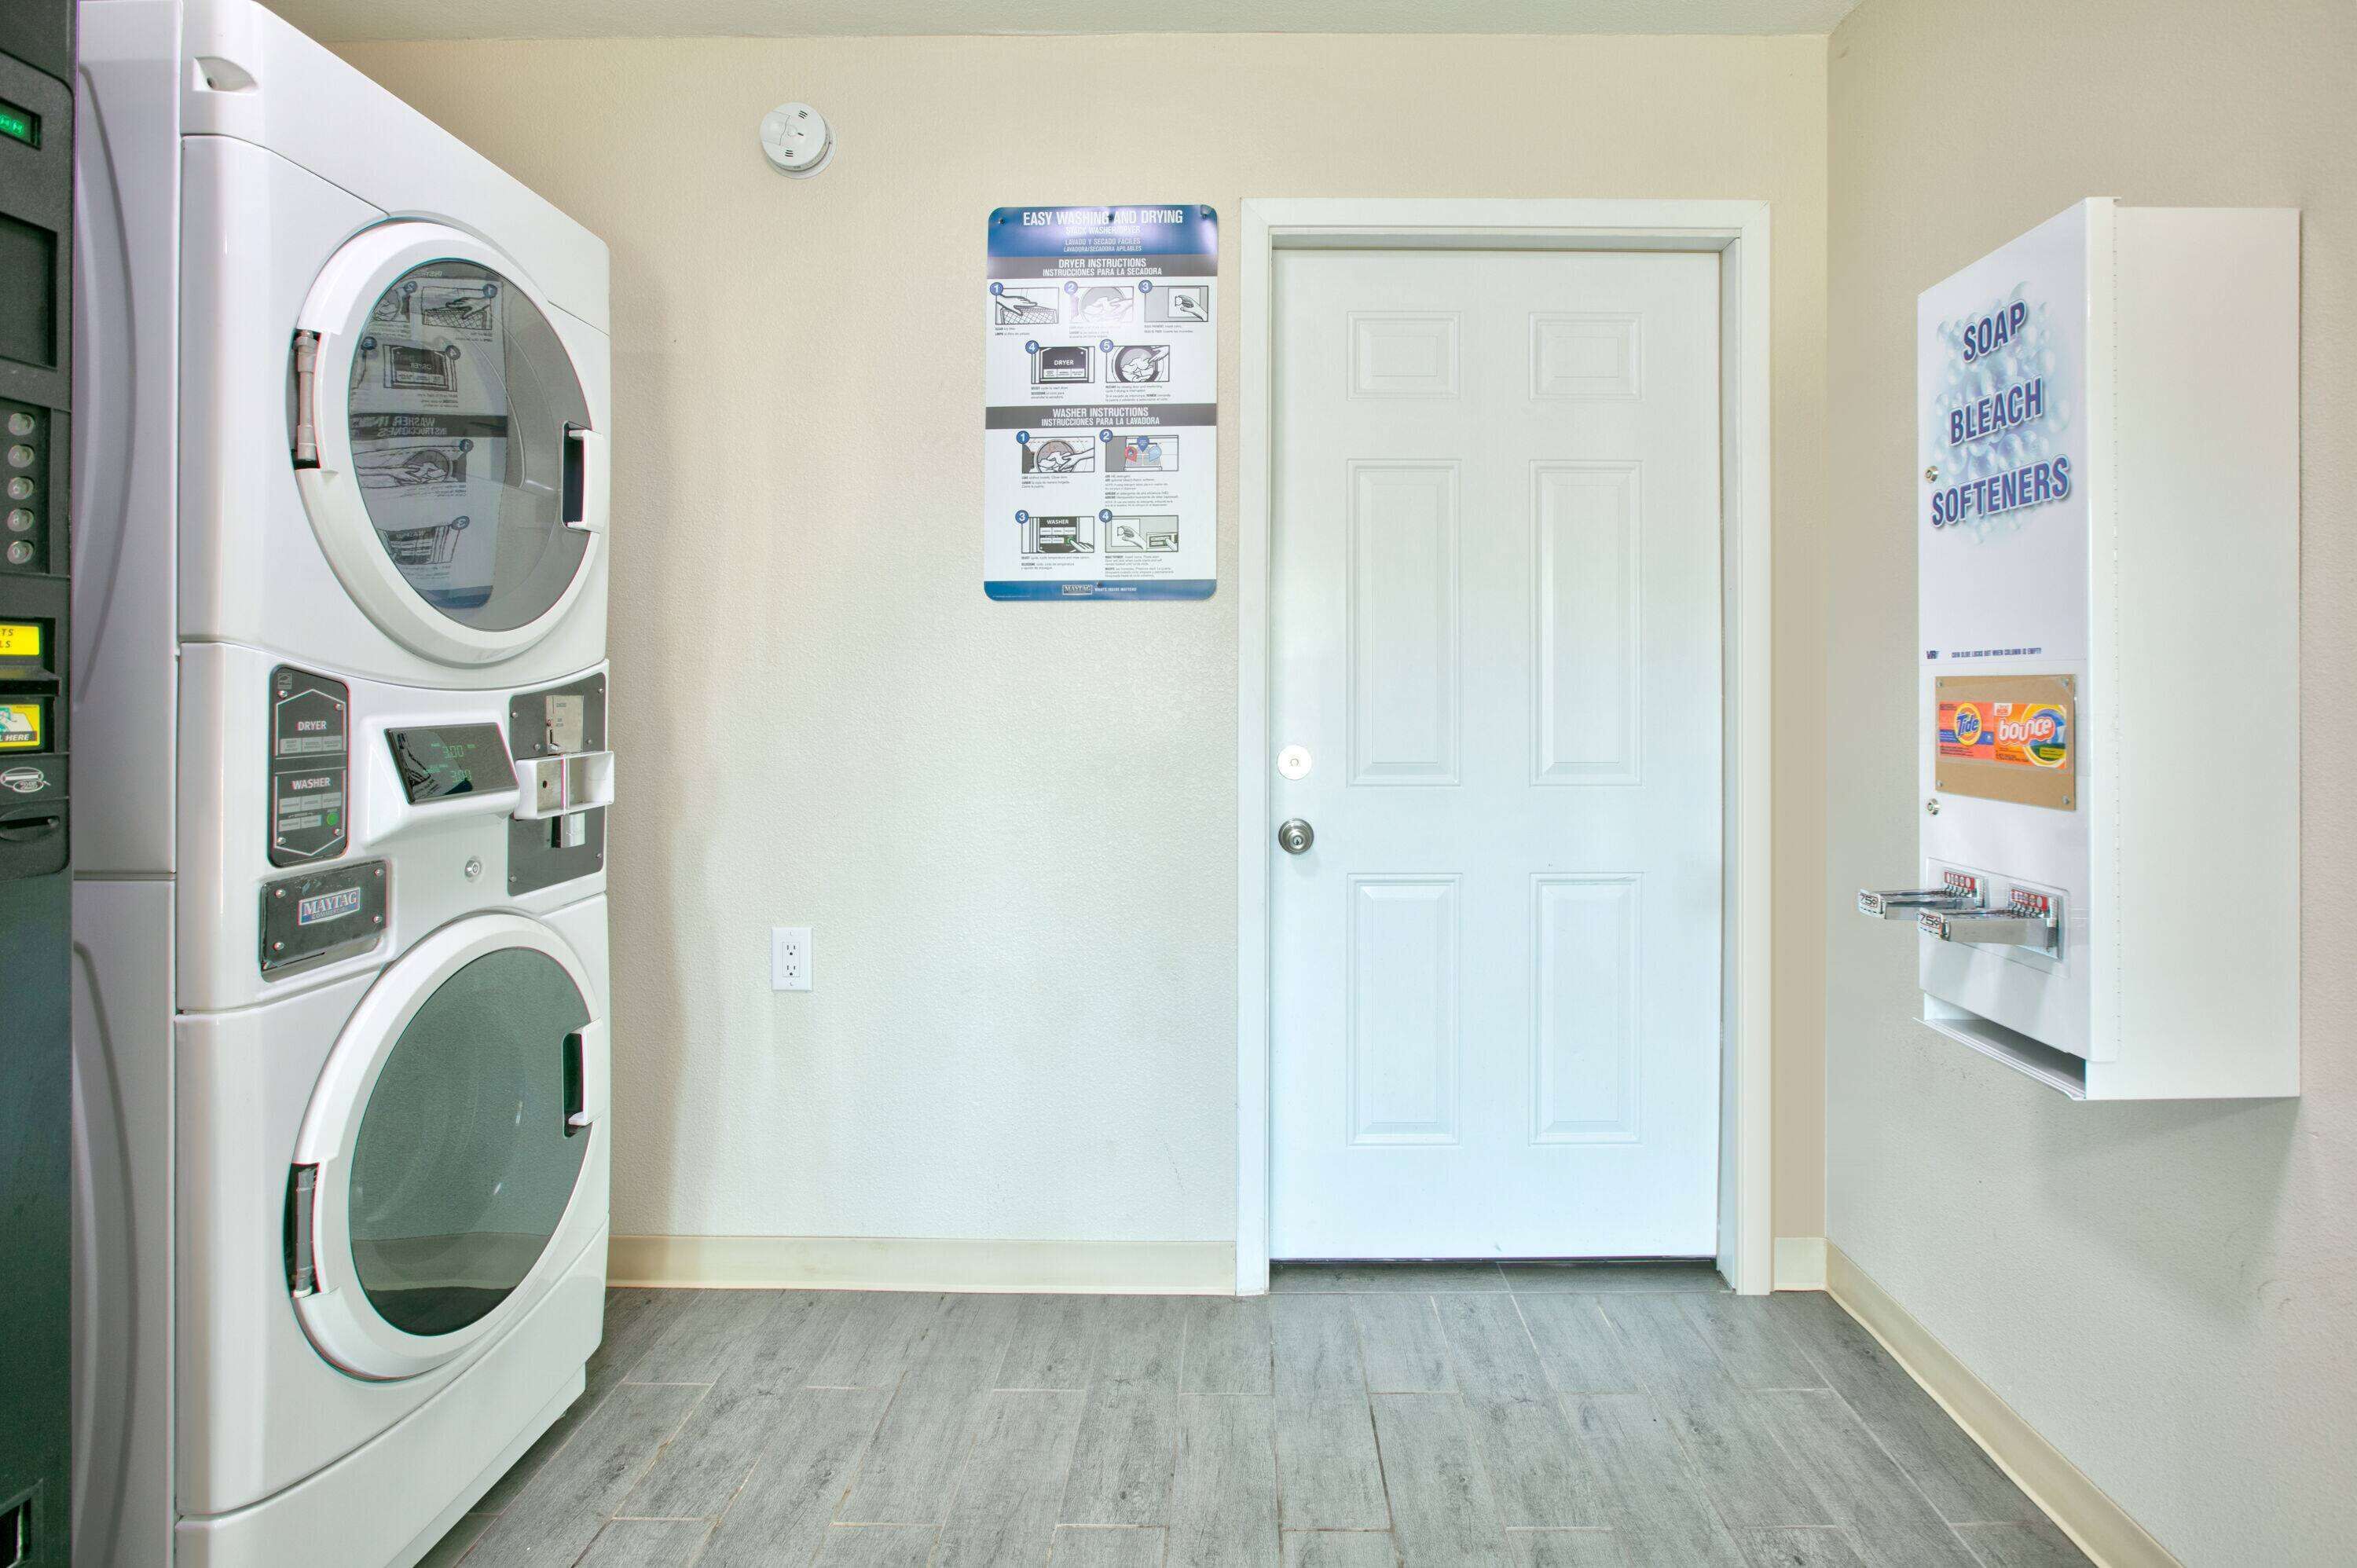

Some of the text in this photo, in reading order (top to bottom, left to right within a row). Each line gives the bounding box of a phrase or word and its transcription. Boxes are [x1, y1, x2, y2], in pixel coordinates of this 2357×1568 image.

[1023, 209, 1183, 226] EASY WASHING AND DRYING
[1065, 226, 1087, 236] STACK
[1058, 258, 1146, 269] DRYER INSTRUCTIONS
[1043, 268, 1094, 277] INSTRUCCIONES
[1097, 267, 1114, 276] PARA
[993, 284, 999, 293] 1
[1068, 284, 1076, 293] 2
[1142, 283, 1149, 291] 3
[1963, 299, 2027, 363] SOAP
[1028, 343, 1036, 352] 4
[1102, 342, 1110, 351] 5
[1053, 407, 1149, 418] WASHER INSTRUCTIONS
[1948, 375, 2044, 446] BLEACH
[1041, 418, 1094, 427] INSTRUCCIONES
[1020, 433, 1025, 442] 1
[1102, 431, 1109, 440] 2
[1931, 454, 2070, 528] SOFTENERS
[1019, 512, 1025, 521] 3
[1102, 511, 1109, 520] 4
[297, 720, 327, 731] DRYER
[1956, 712, 1979, 738] Tide
[1998, 716, 2052, 742] bounce
[291, 777, 330, 789] WASHER
[303, 892, 357, 915] MAYTAG
